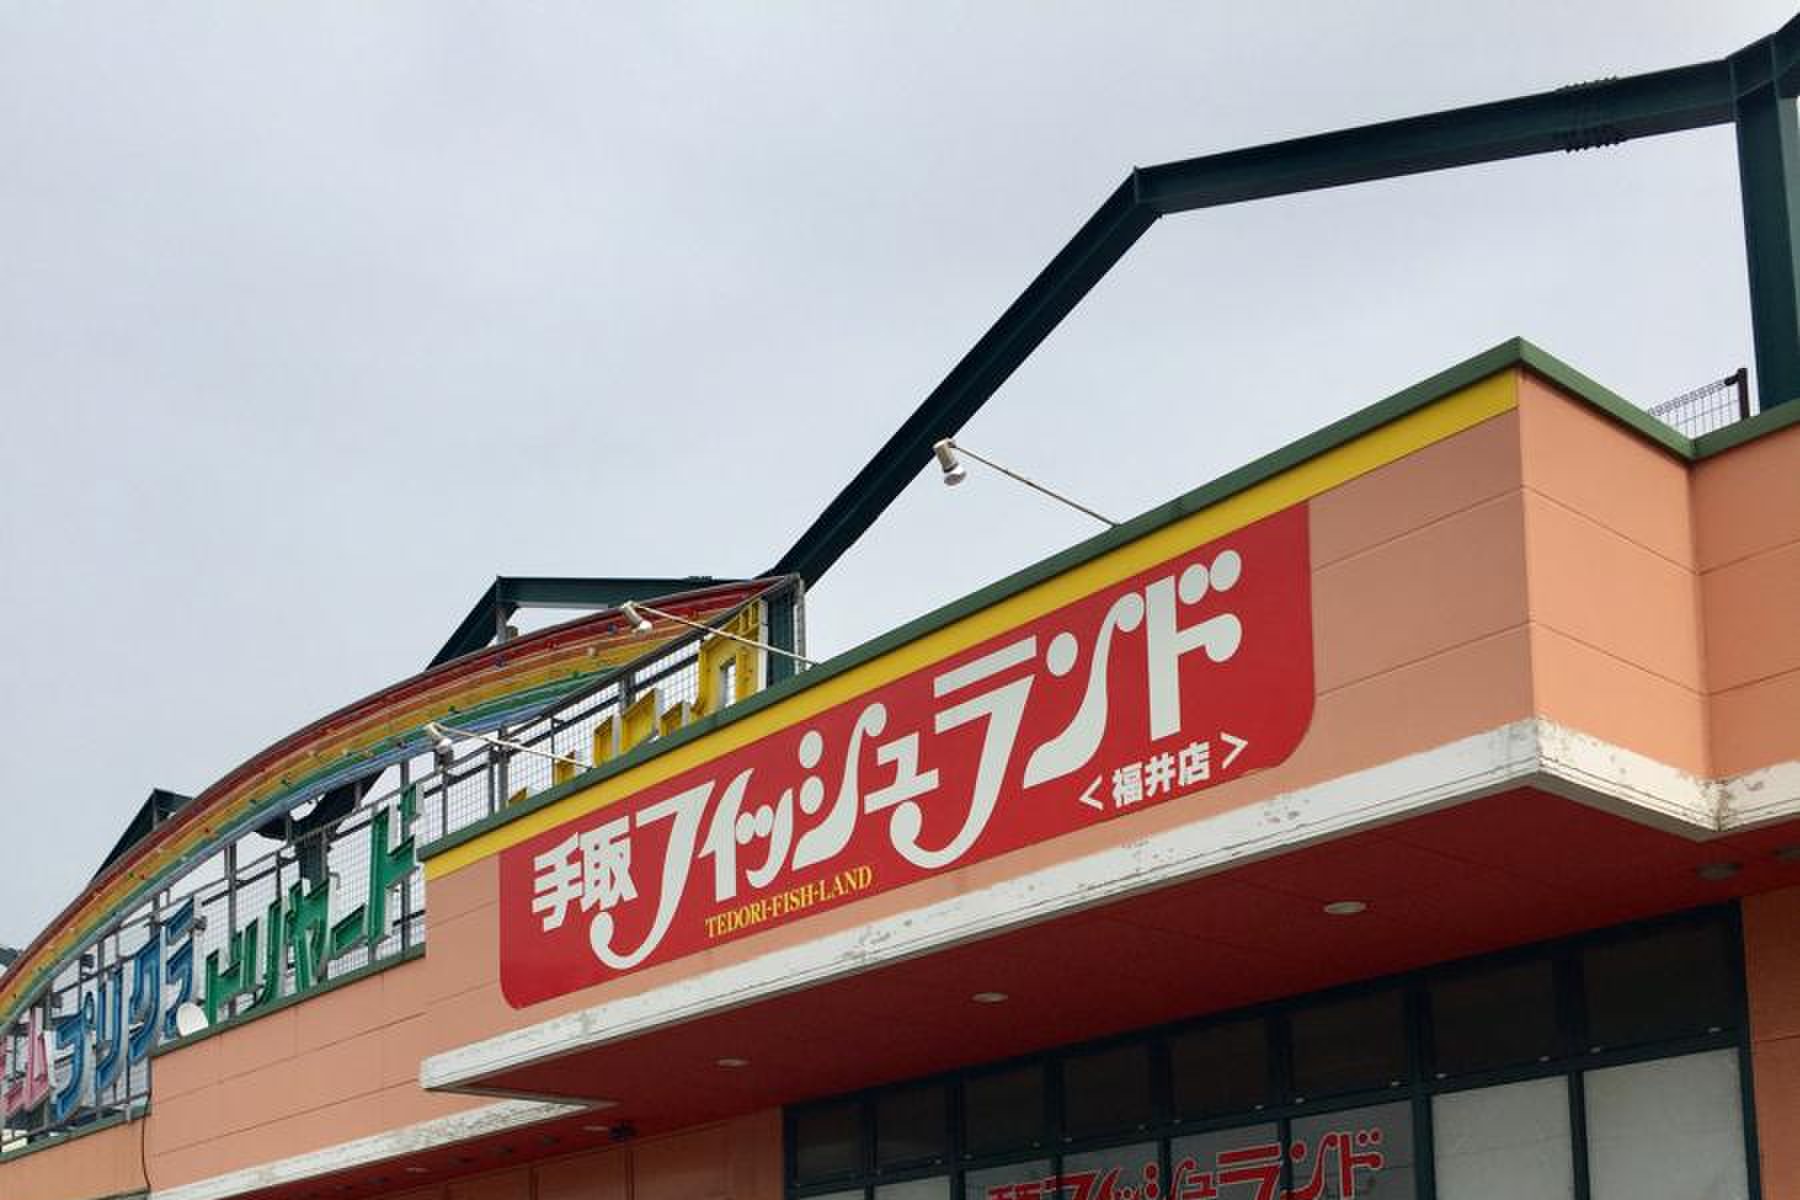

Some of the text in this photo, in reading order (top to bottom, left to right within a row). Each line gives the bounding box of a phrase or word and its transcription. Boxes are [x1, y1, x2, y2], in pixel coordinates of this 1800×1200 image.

[532, 549, 1242, 969] 手取フィッシュランド
